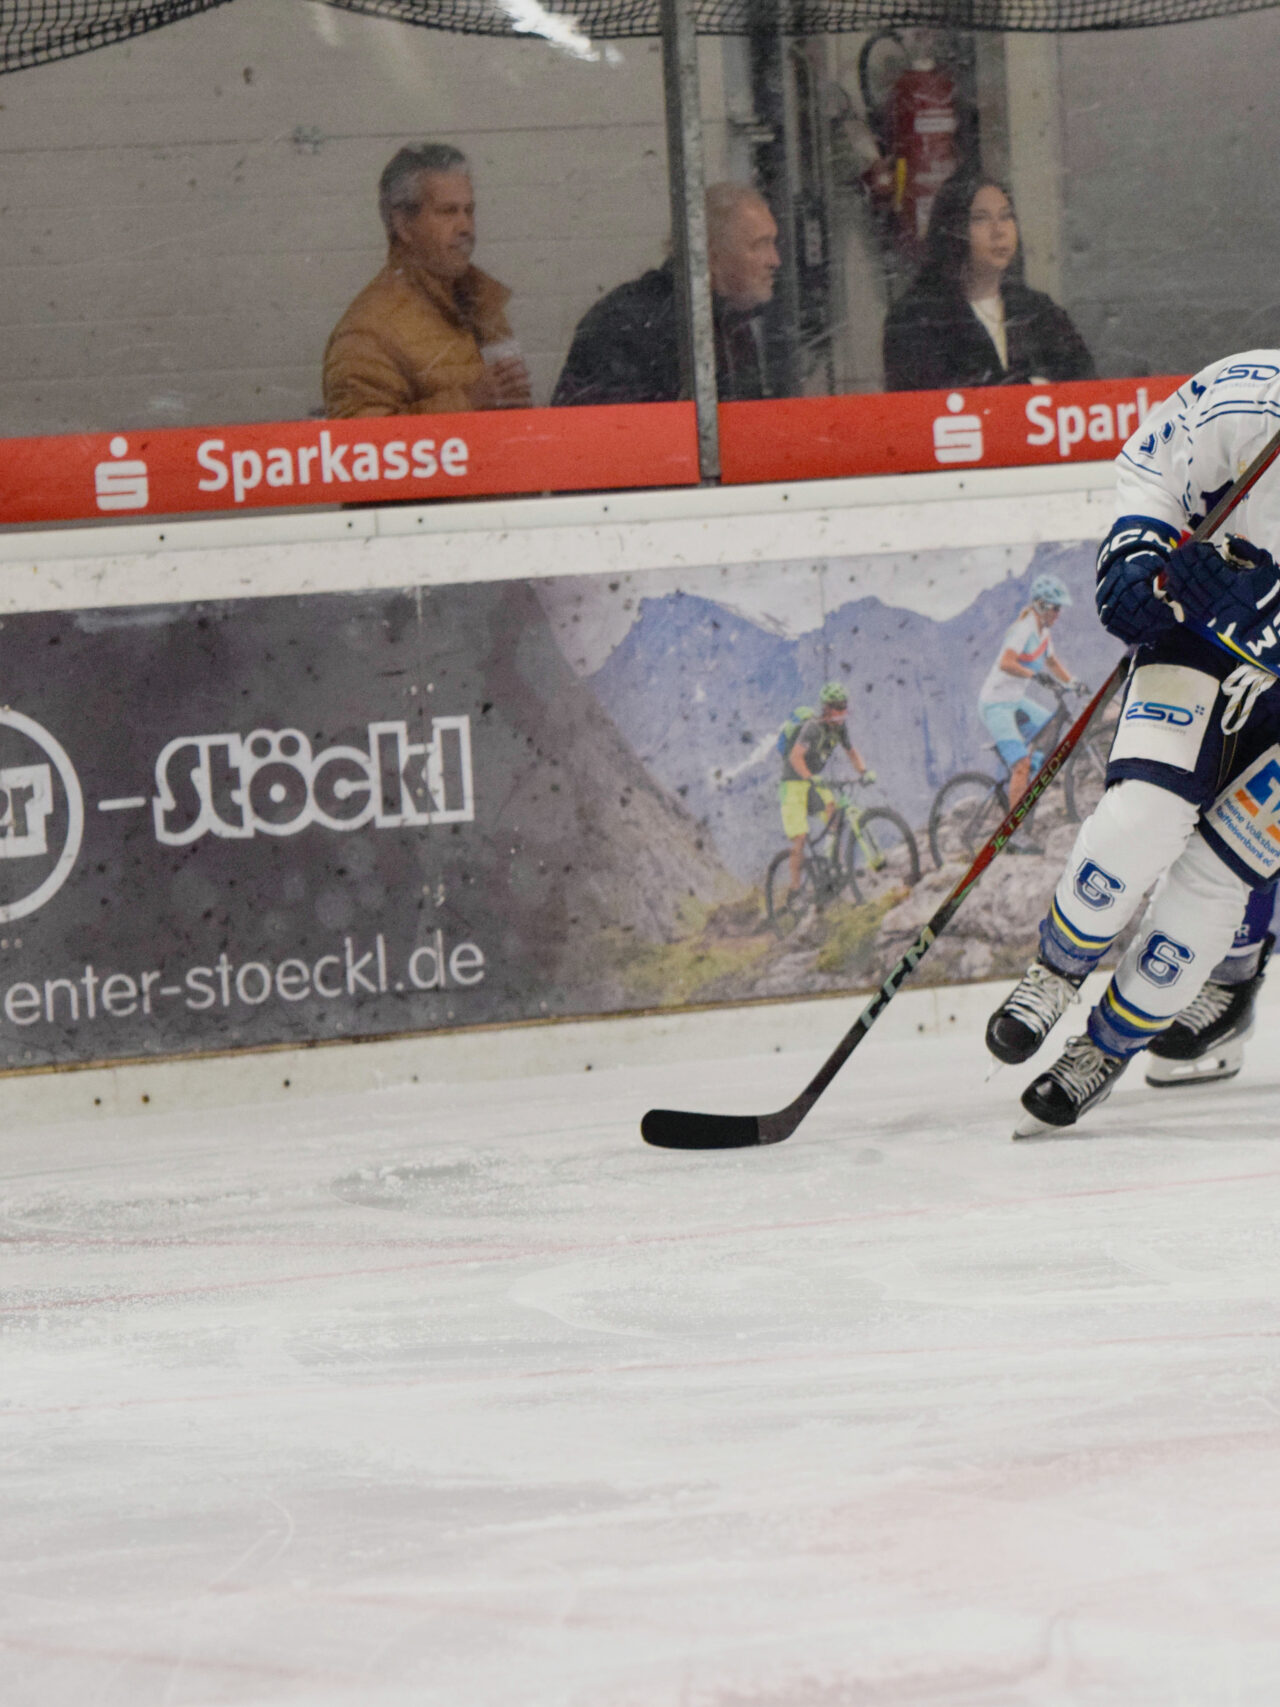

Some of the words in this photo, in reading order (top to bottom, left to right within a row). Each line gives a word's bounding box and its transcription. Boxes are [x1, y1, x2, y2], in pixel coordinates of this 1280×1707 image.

[1025, 387, 1150, 456] Spark
[197, 431, 469, 502] Sparkasse
[1126, 701, 1194, 727] ESD
[3, 930, 486, 1026] enter-stoeckl.de
[861, 926, 938, 1031] CCM
